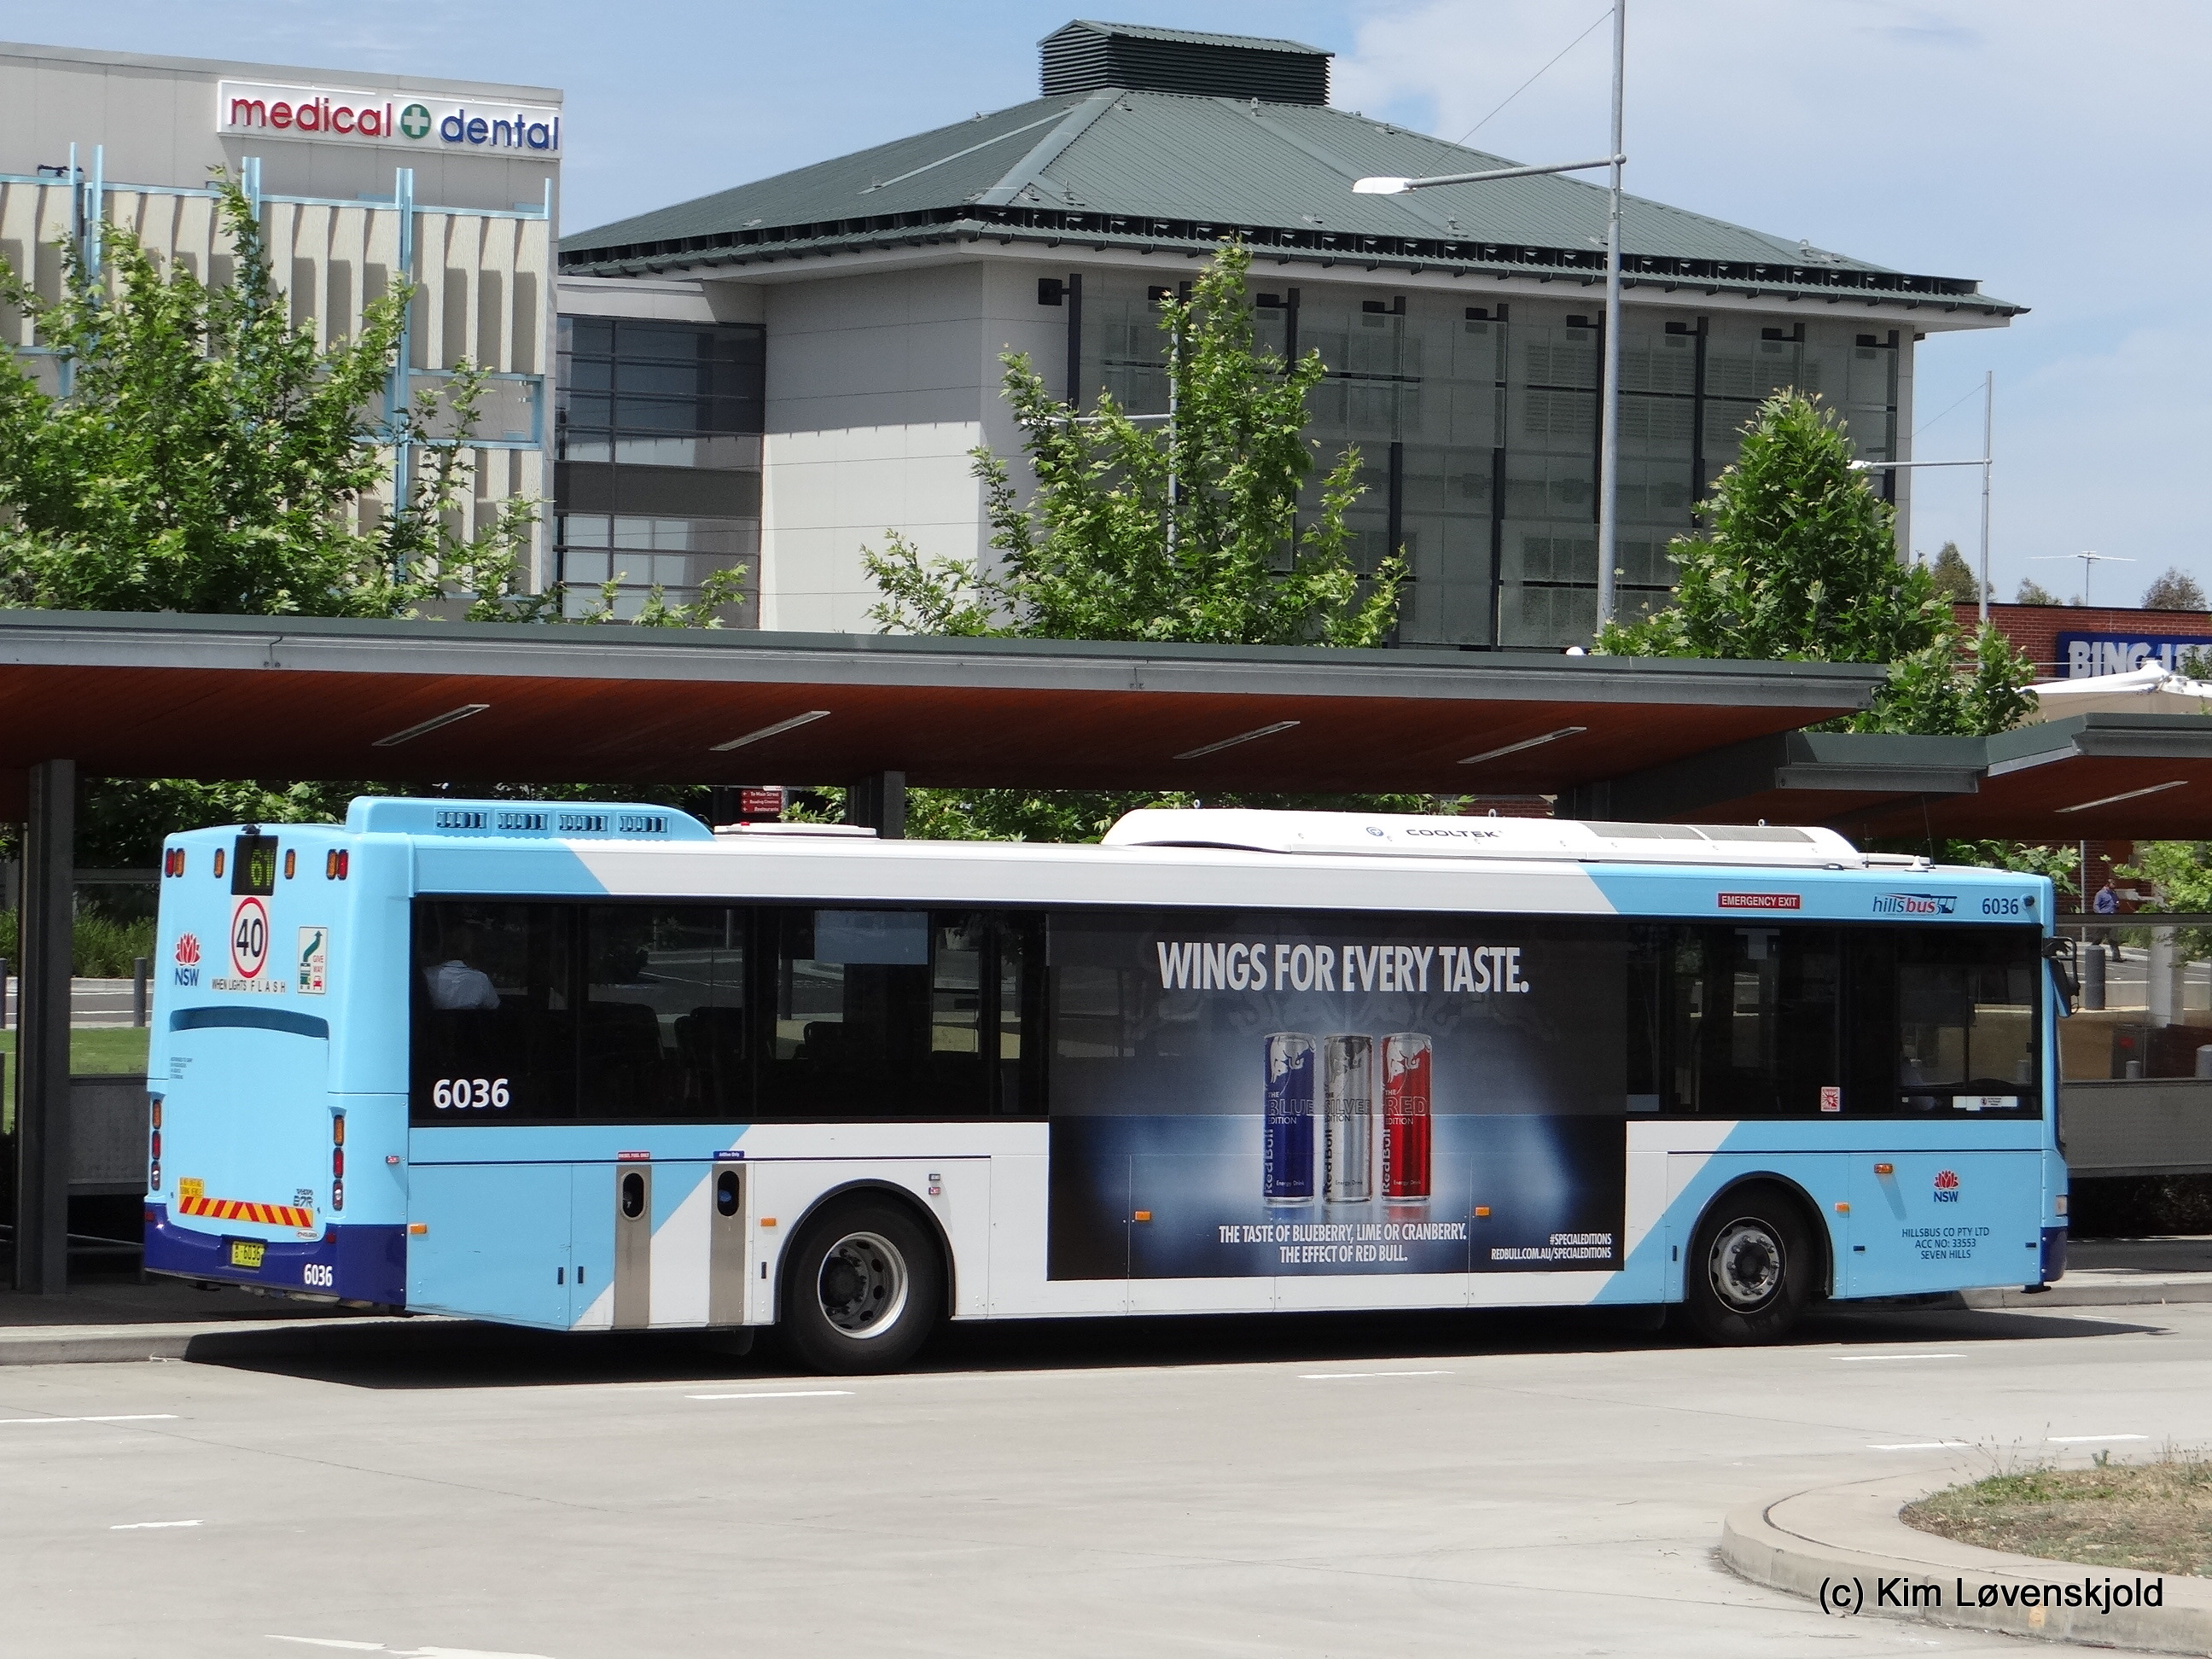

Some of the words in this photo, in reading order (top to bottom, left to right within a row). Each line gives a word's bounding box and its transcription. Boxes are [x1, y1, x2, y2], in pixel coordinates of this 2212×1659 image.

[230, 96, 392, 137] medical
[440, 108, 560, 150] dental
[1406, 829, 1499, 838] COOLTEK
[1721, 895, 1776, 907] EMERGENCY
[1778, 896, 1797, 907] EXIT
[1872, 896, 1936, 913] hillsbus
[1982, 898, 2018, 915] 6036
[236, 917, 264, 958] 40
[1157, 941, 1267, 991] WINGS
[1275, 942, 1335, 992] FOR
[1342, 945, 1432, 992] EVERY
[1438, 946, 1529, 993] TASTE.
[175, 967, 199, 987] NSW
[212, 978, 227, 990] WHEN
[229, 979, 247, 991] LIGHTS
[433, 1078, 509, 1109] 6036
[1268, 1098, 1314, 1116] BLUE
[1385, 1097, 1428, 1116] RED
[1934, 1190, 1959, 1202] NSW
[1219, 1225, 1240, 1243] THE
[1243, 1225, 1274, 1243] TASTE
[1275, 1225, 1290, 1243] OF
[1292, 1224, 1353, 1243] BLUEBERRY,
[1356, 1224, 1382, 1241] LIME
[1383, 1224, 1400, 1241] OR
[1401, 1223, 1467, 1240] CRANBERRY.
[1549, 1233, 1612, 1245] #SPECIALEDITIONS
[1901, 1228, 1941, 1237] HILLSBUS
[1943, 1228, 1955, 1237] CO
[1957, 1227, 1972, 1237] PTY
[1975, 1227, 1990, 1237] LTD
[1914, 1239, 1932, 1249] ACC
[1935, 1239, 1950, 1248] NO:
[1953, 1238, 1976, 1248] 33553
[1280, 1246, 1300, 1263] THE
[1302, 1245, 1337, 1263] EFFECT
[1339, 1245, 1353, 1262] OF
[1355, 1245, 1377, 1262] RED
[1378, 1244, 1408, 1261] BULL.
[1491, 1247, 1612, 1260] REDBULL.COM.AU/SPECIALEDITIONS
[1921, 1249, 1947, 1260] SEVEN
[1949, 1249, 1971, 1259] HILLS
[304, 1263, 333, 1287] 6036
